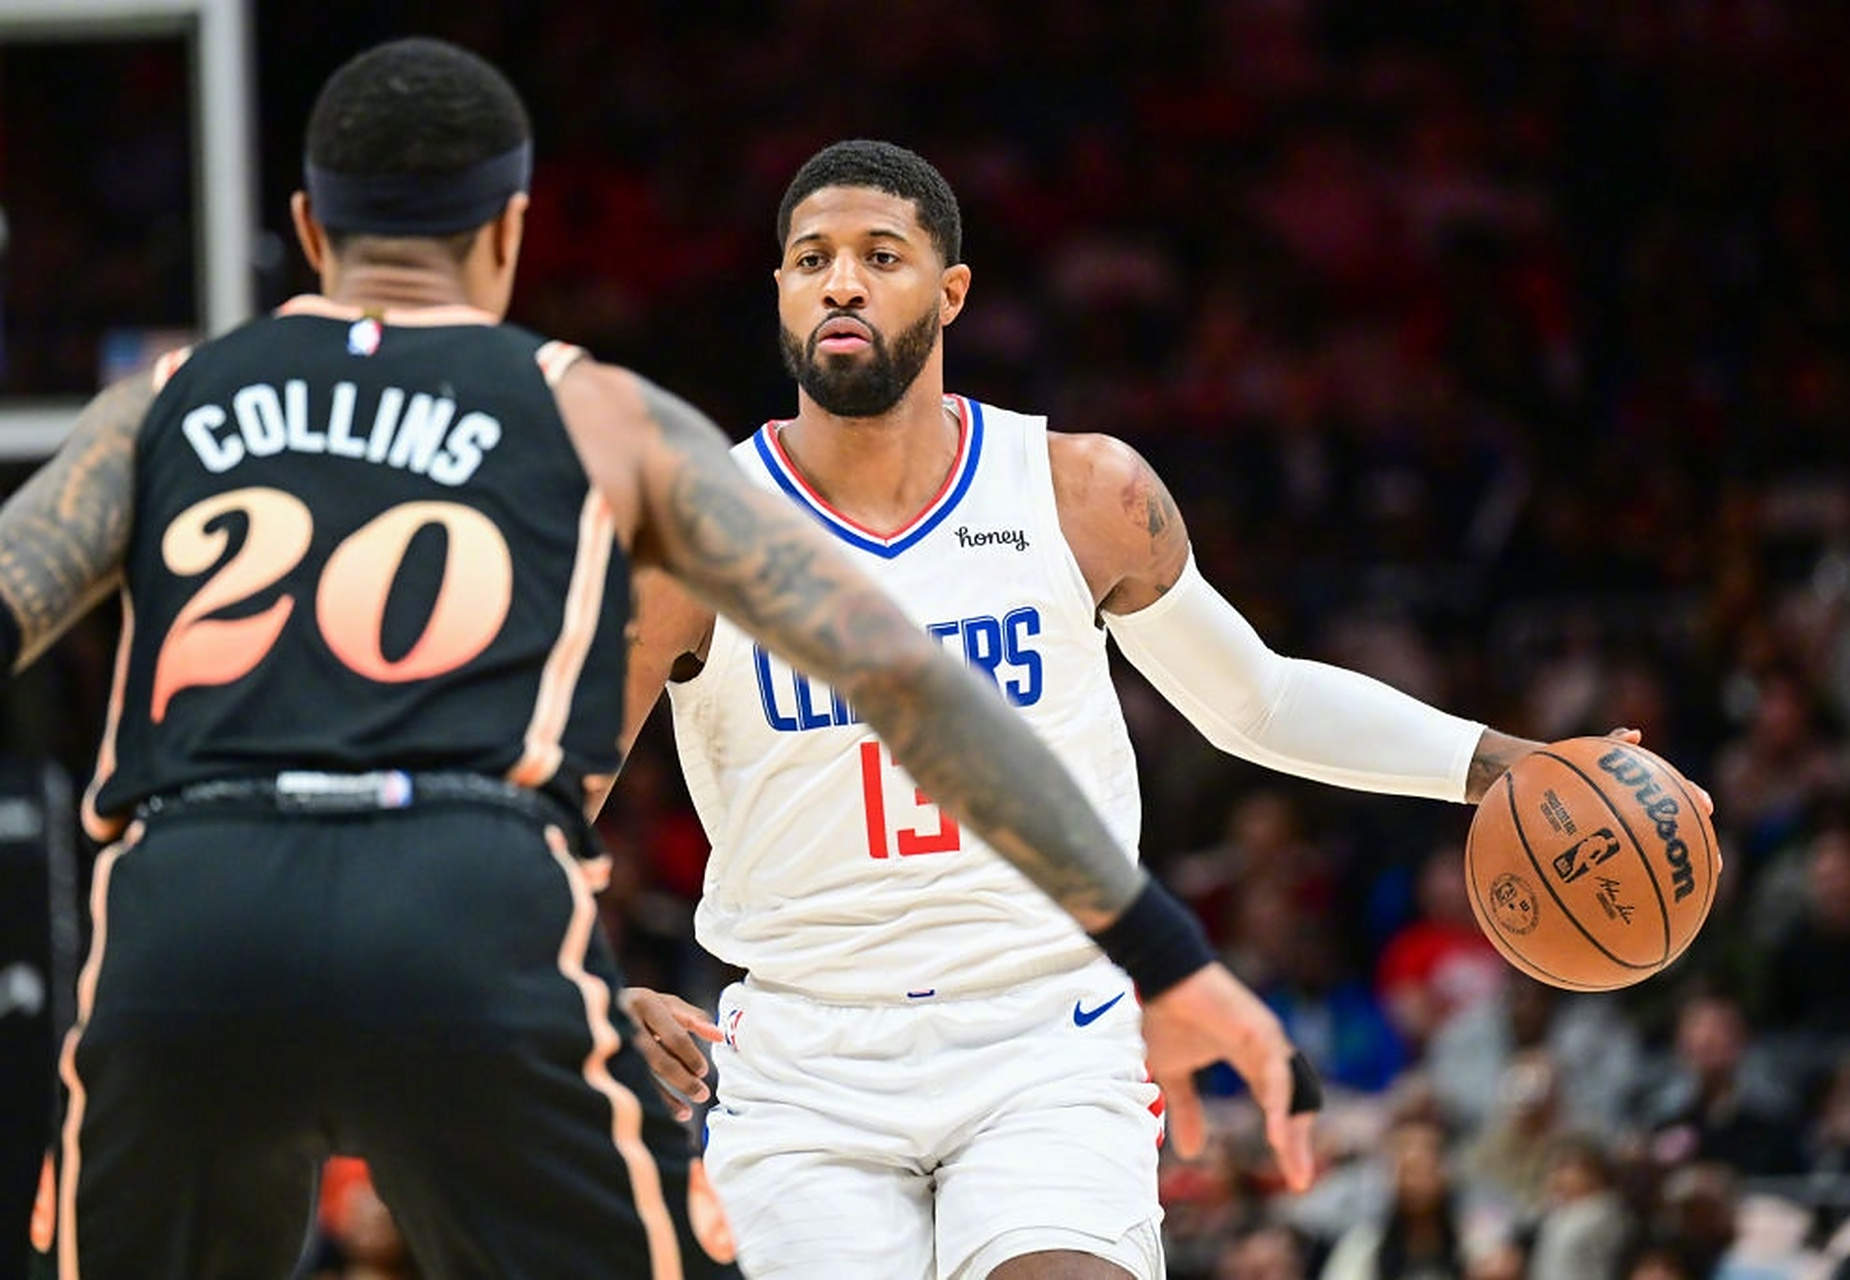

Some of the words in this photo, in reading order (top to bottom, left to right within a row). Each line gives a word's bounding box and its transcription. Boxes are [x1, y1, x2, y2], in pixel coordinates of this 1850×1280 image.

[182, 379, 501, 486] COLLINS
[954, 526, 1030, 552] honey
[149, 486, 514, 725] 20
[1597, 748, 1696, 904] Wilson
